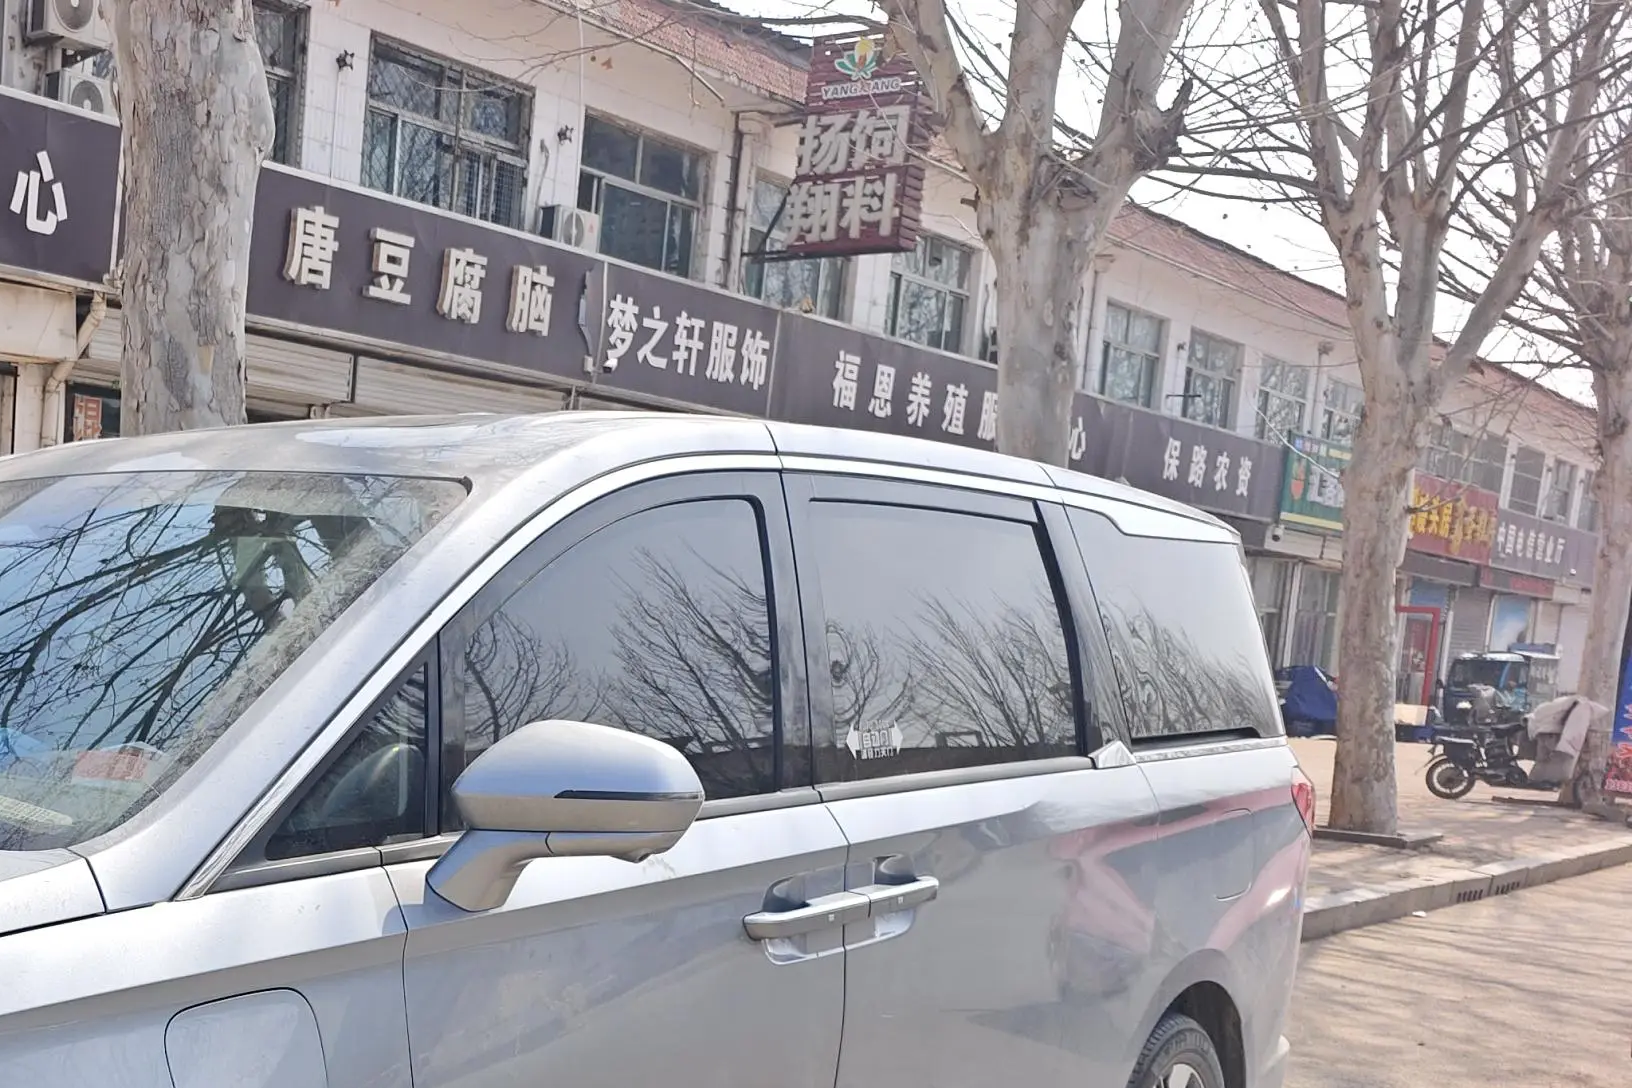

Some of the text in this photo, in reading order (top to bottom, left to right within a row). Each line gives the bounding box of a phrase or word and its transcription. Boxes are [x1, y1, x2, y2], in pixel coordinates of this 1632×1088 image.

[283, 205, 556, 337] 唐豆腐脑
[606, 294, 770, 391] 梦之轩服饰
